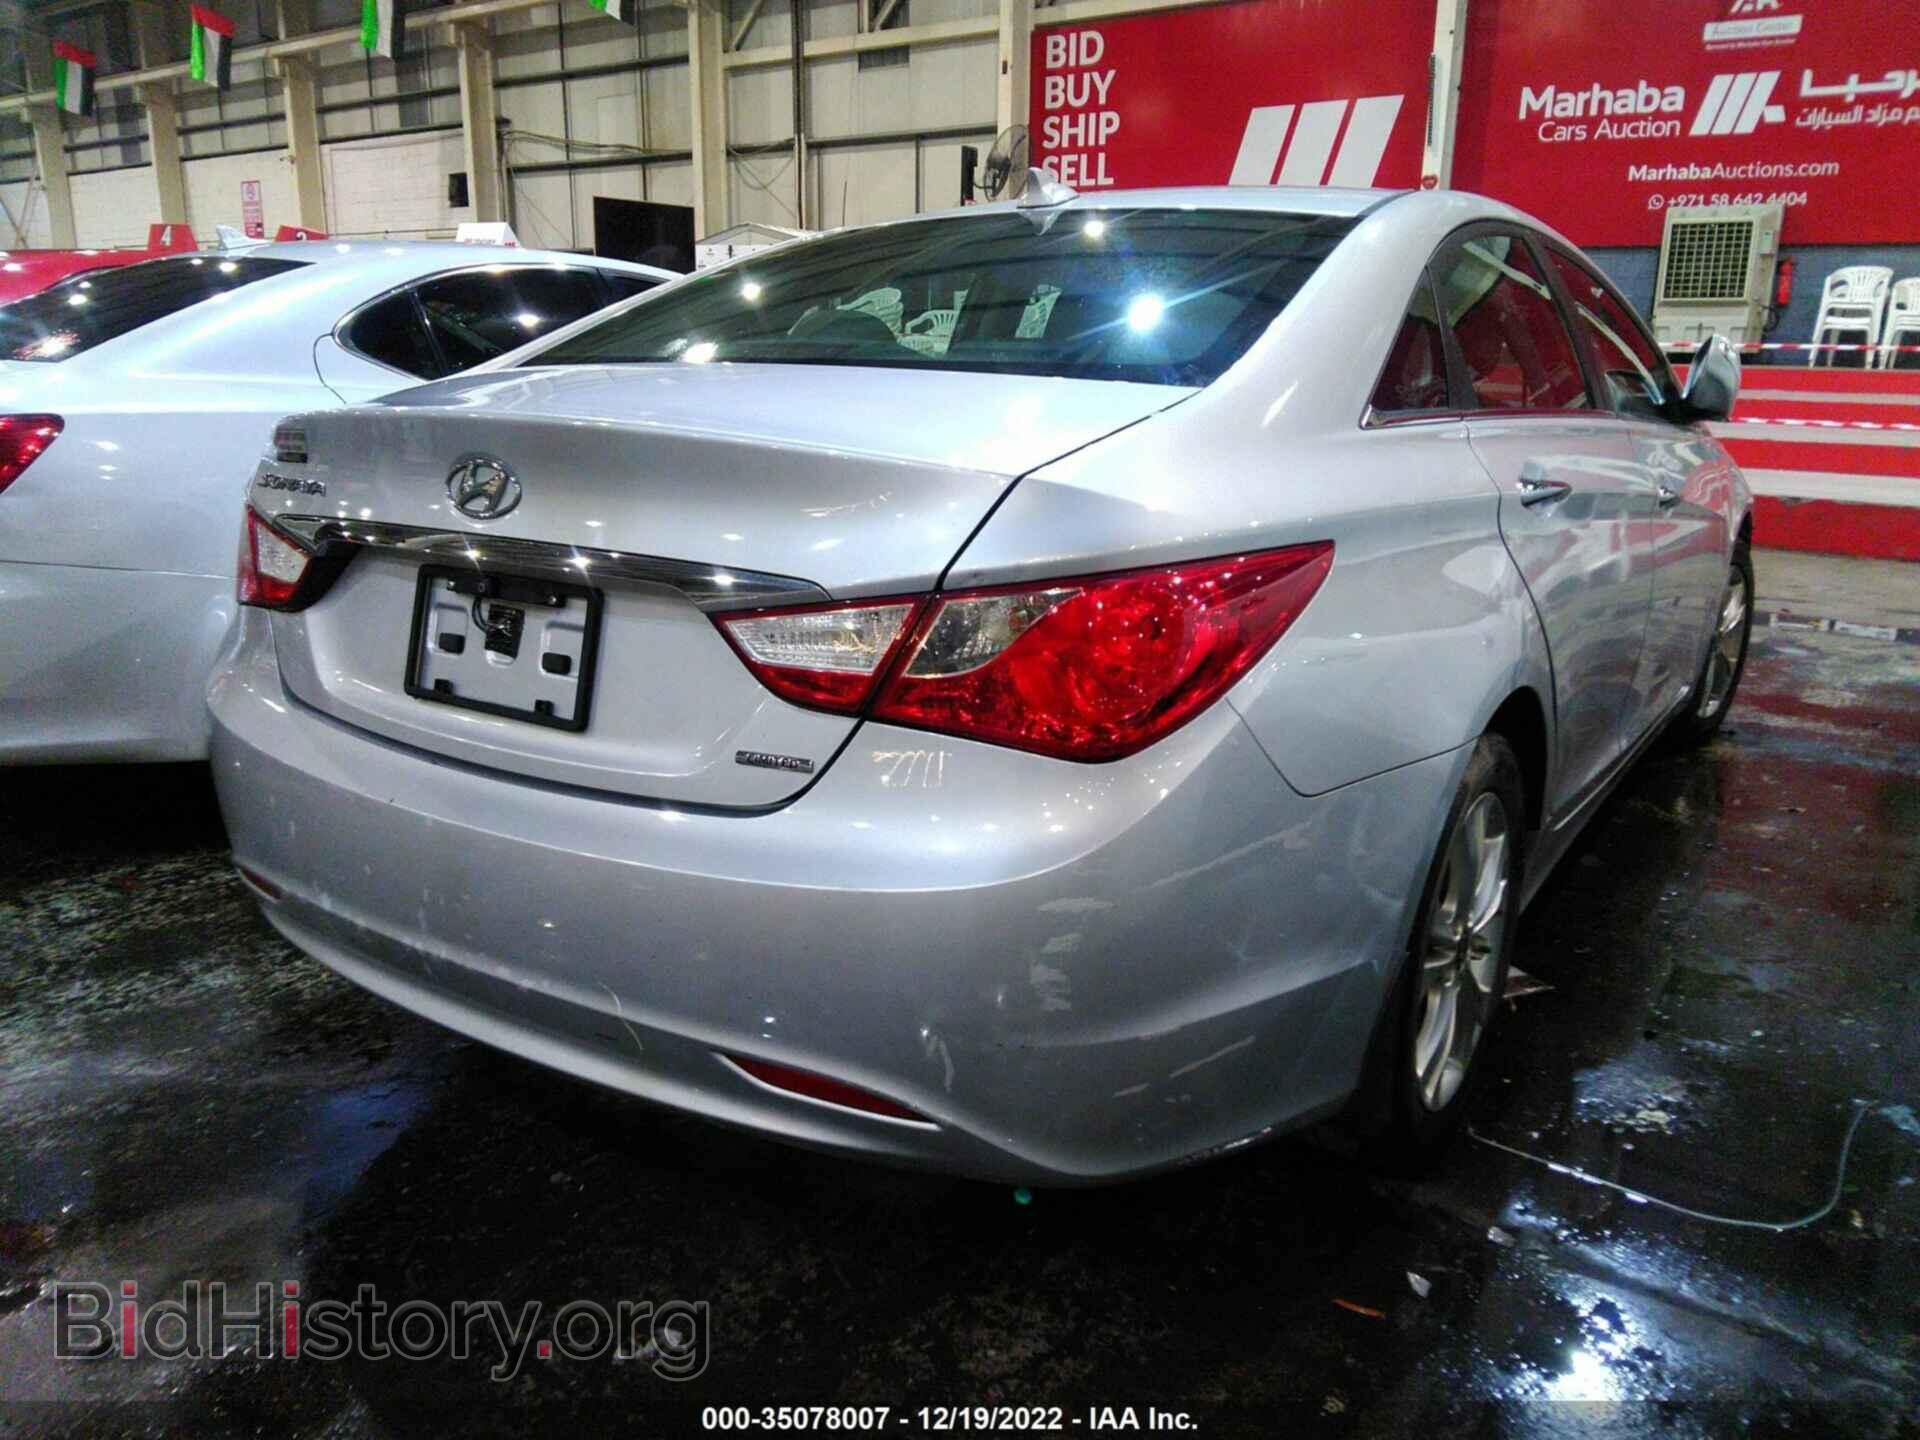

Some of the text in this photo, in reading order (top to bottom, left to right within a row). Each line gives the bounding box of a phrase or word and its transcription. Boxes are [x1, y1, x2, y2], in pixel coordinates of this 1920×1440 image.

[1046, 30, 1104, 69] BID
[1045, 69, 1116, 110] BUY
[1519, 79, 1685, 120] Marhaba
[1800, 68, 1920, 103] رحبا
[1042, 111, 1120, 149] SHIP
[1538, 116, 1680, 142] Cars Auction
[1042, 152, 1114, 187] SELL
[1629, 161, 1840, 181] MarhabaAuctions.com
[160, 226, 172, 246] 4
